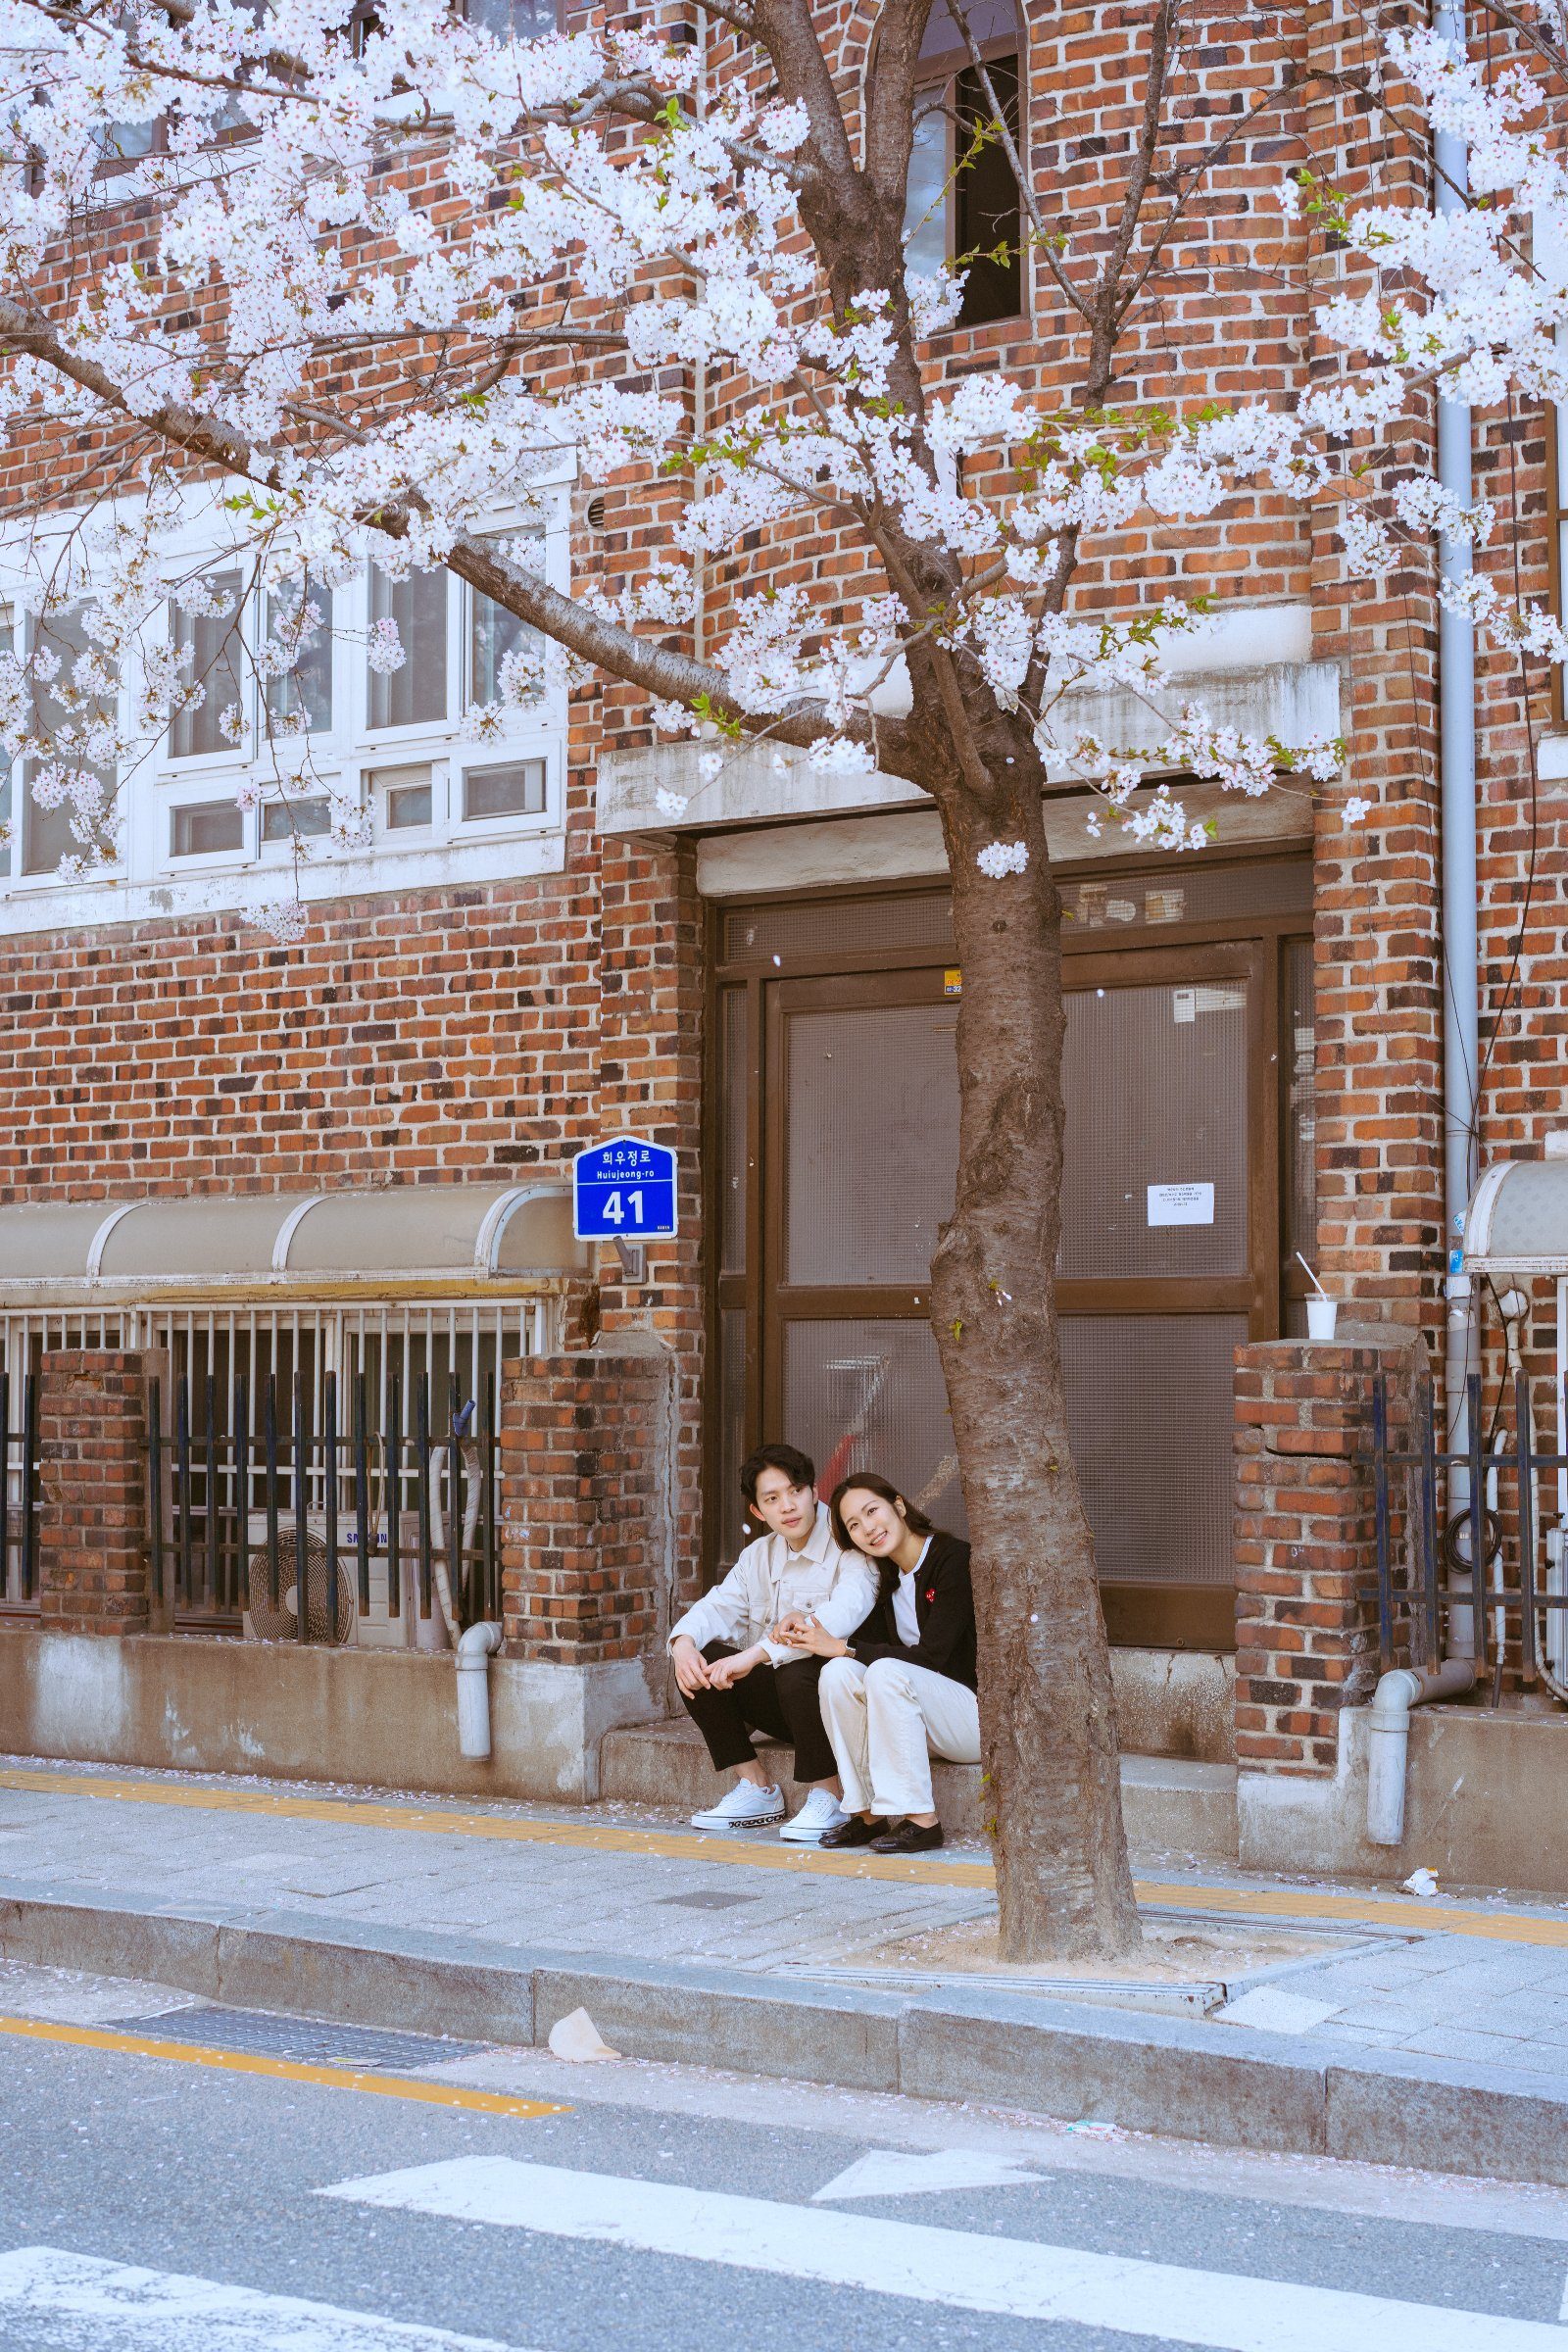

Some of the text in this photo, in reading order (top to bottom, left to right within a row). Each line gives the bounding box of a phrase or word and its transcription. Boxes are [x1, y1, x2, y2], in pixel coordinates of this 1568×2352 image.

[603, 1150, 651, 1167] 희우정로
[597, 1169, 654, 1181] Huiujeong-ro
[603, 1191, 644, 1224] 41
